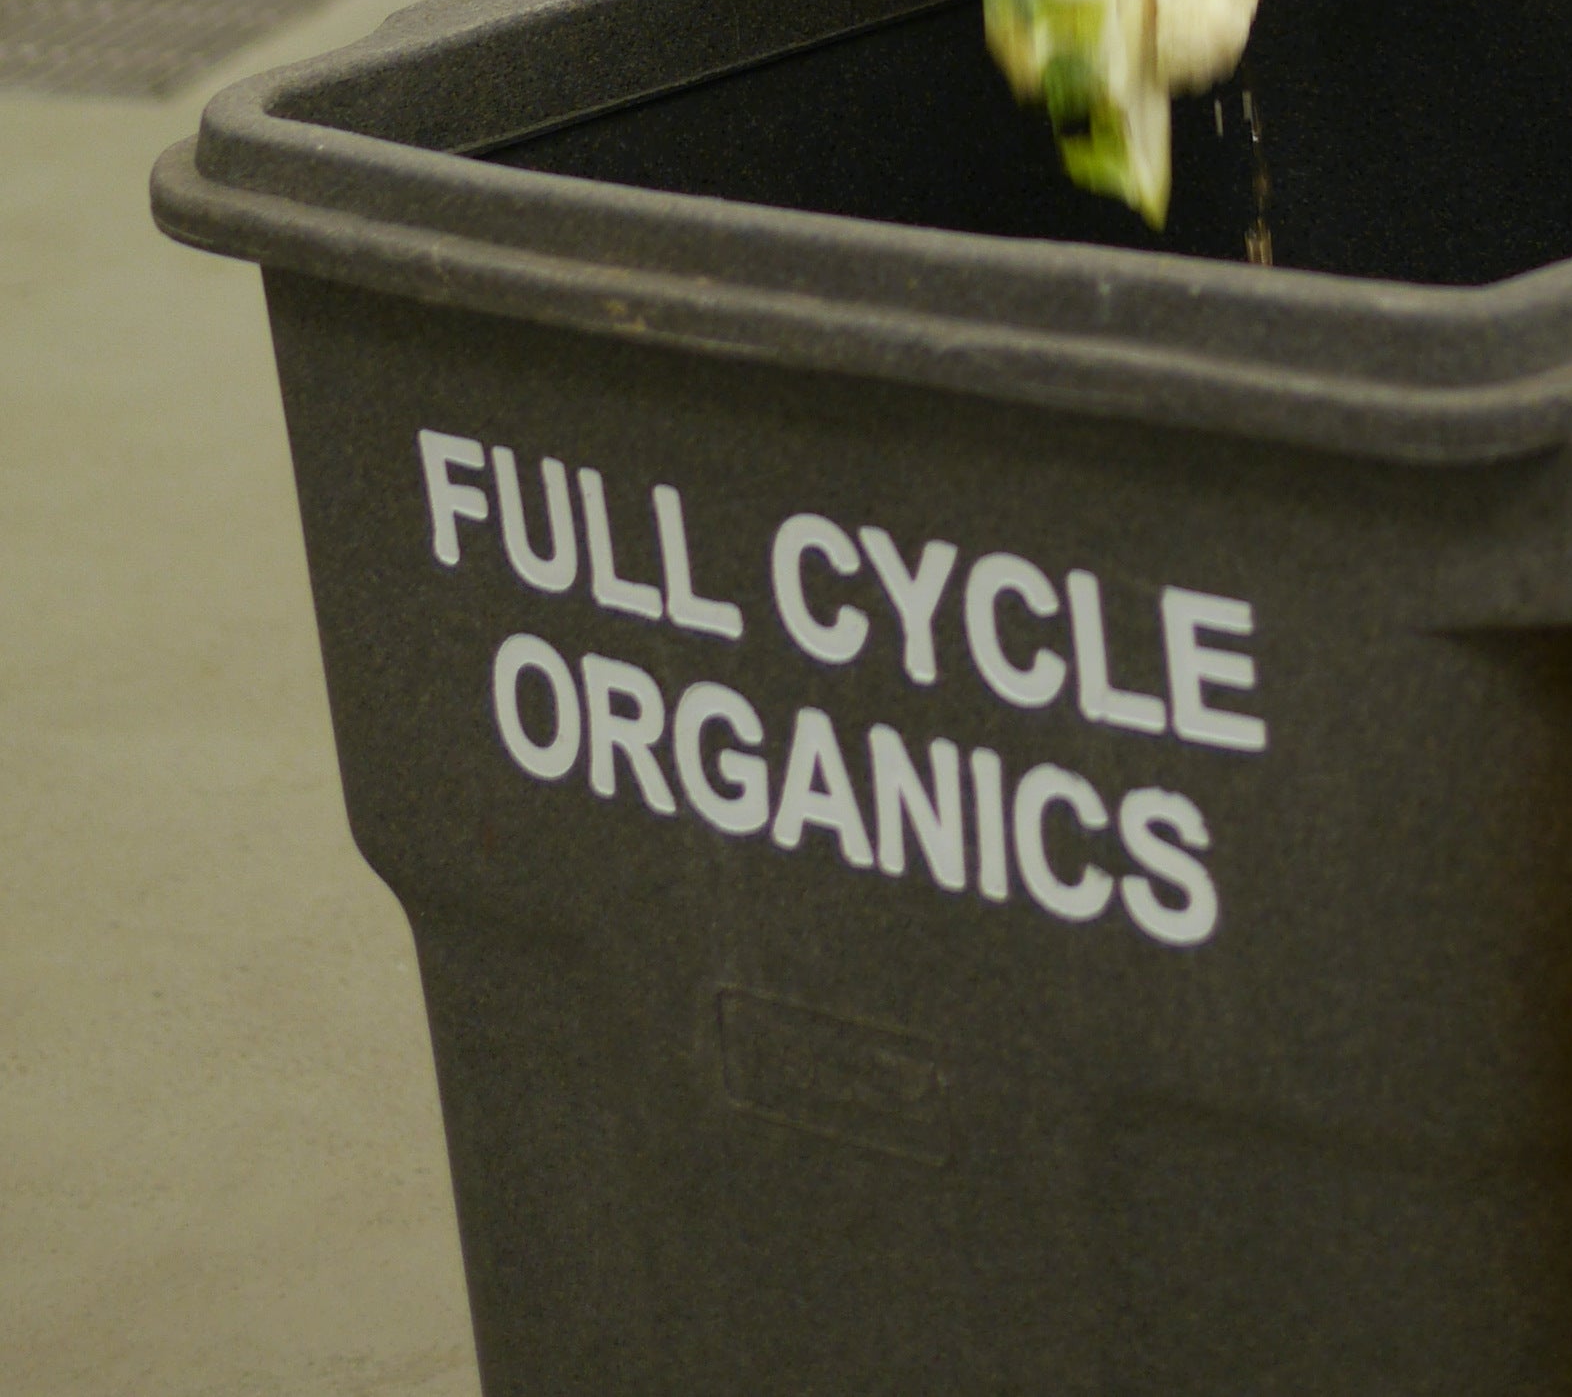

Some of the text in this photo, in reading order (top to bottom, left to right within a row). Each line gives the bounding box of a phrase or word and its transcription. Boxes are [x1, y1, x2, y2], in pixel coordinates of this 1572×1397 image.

[419, 429, 1267, 752] FULL CYCLE
[494, 633, 1220, 947] ORGANICS
